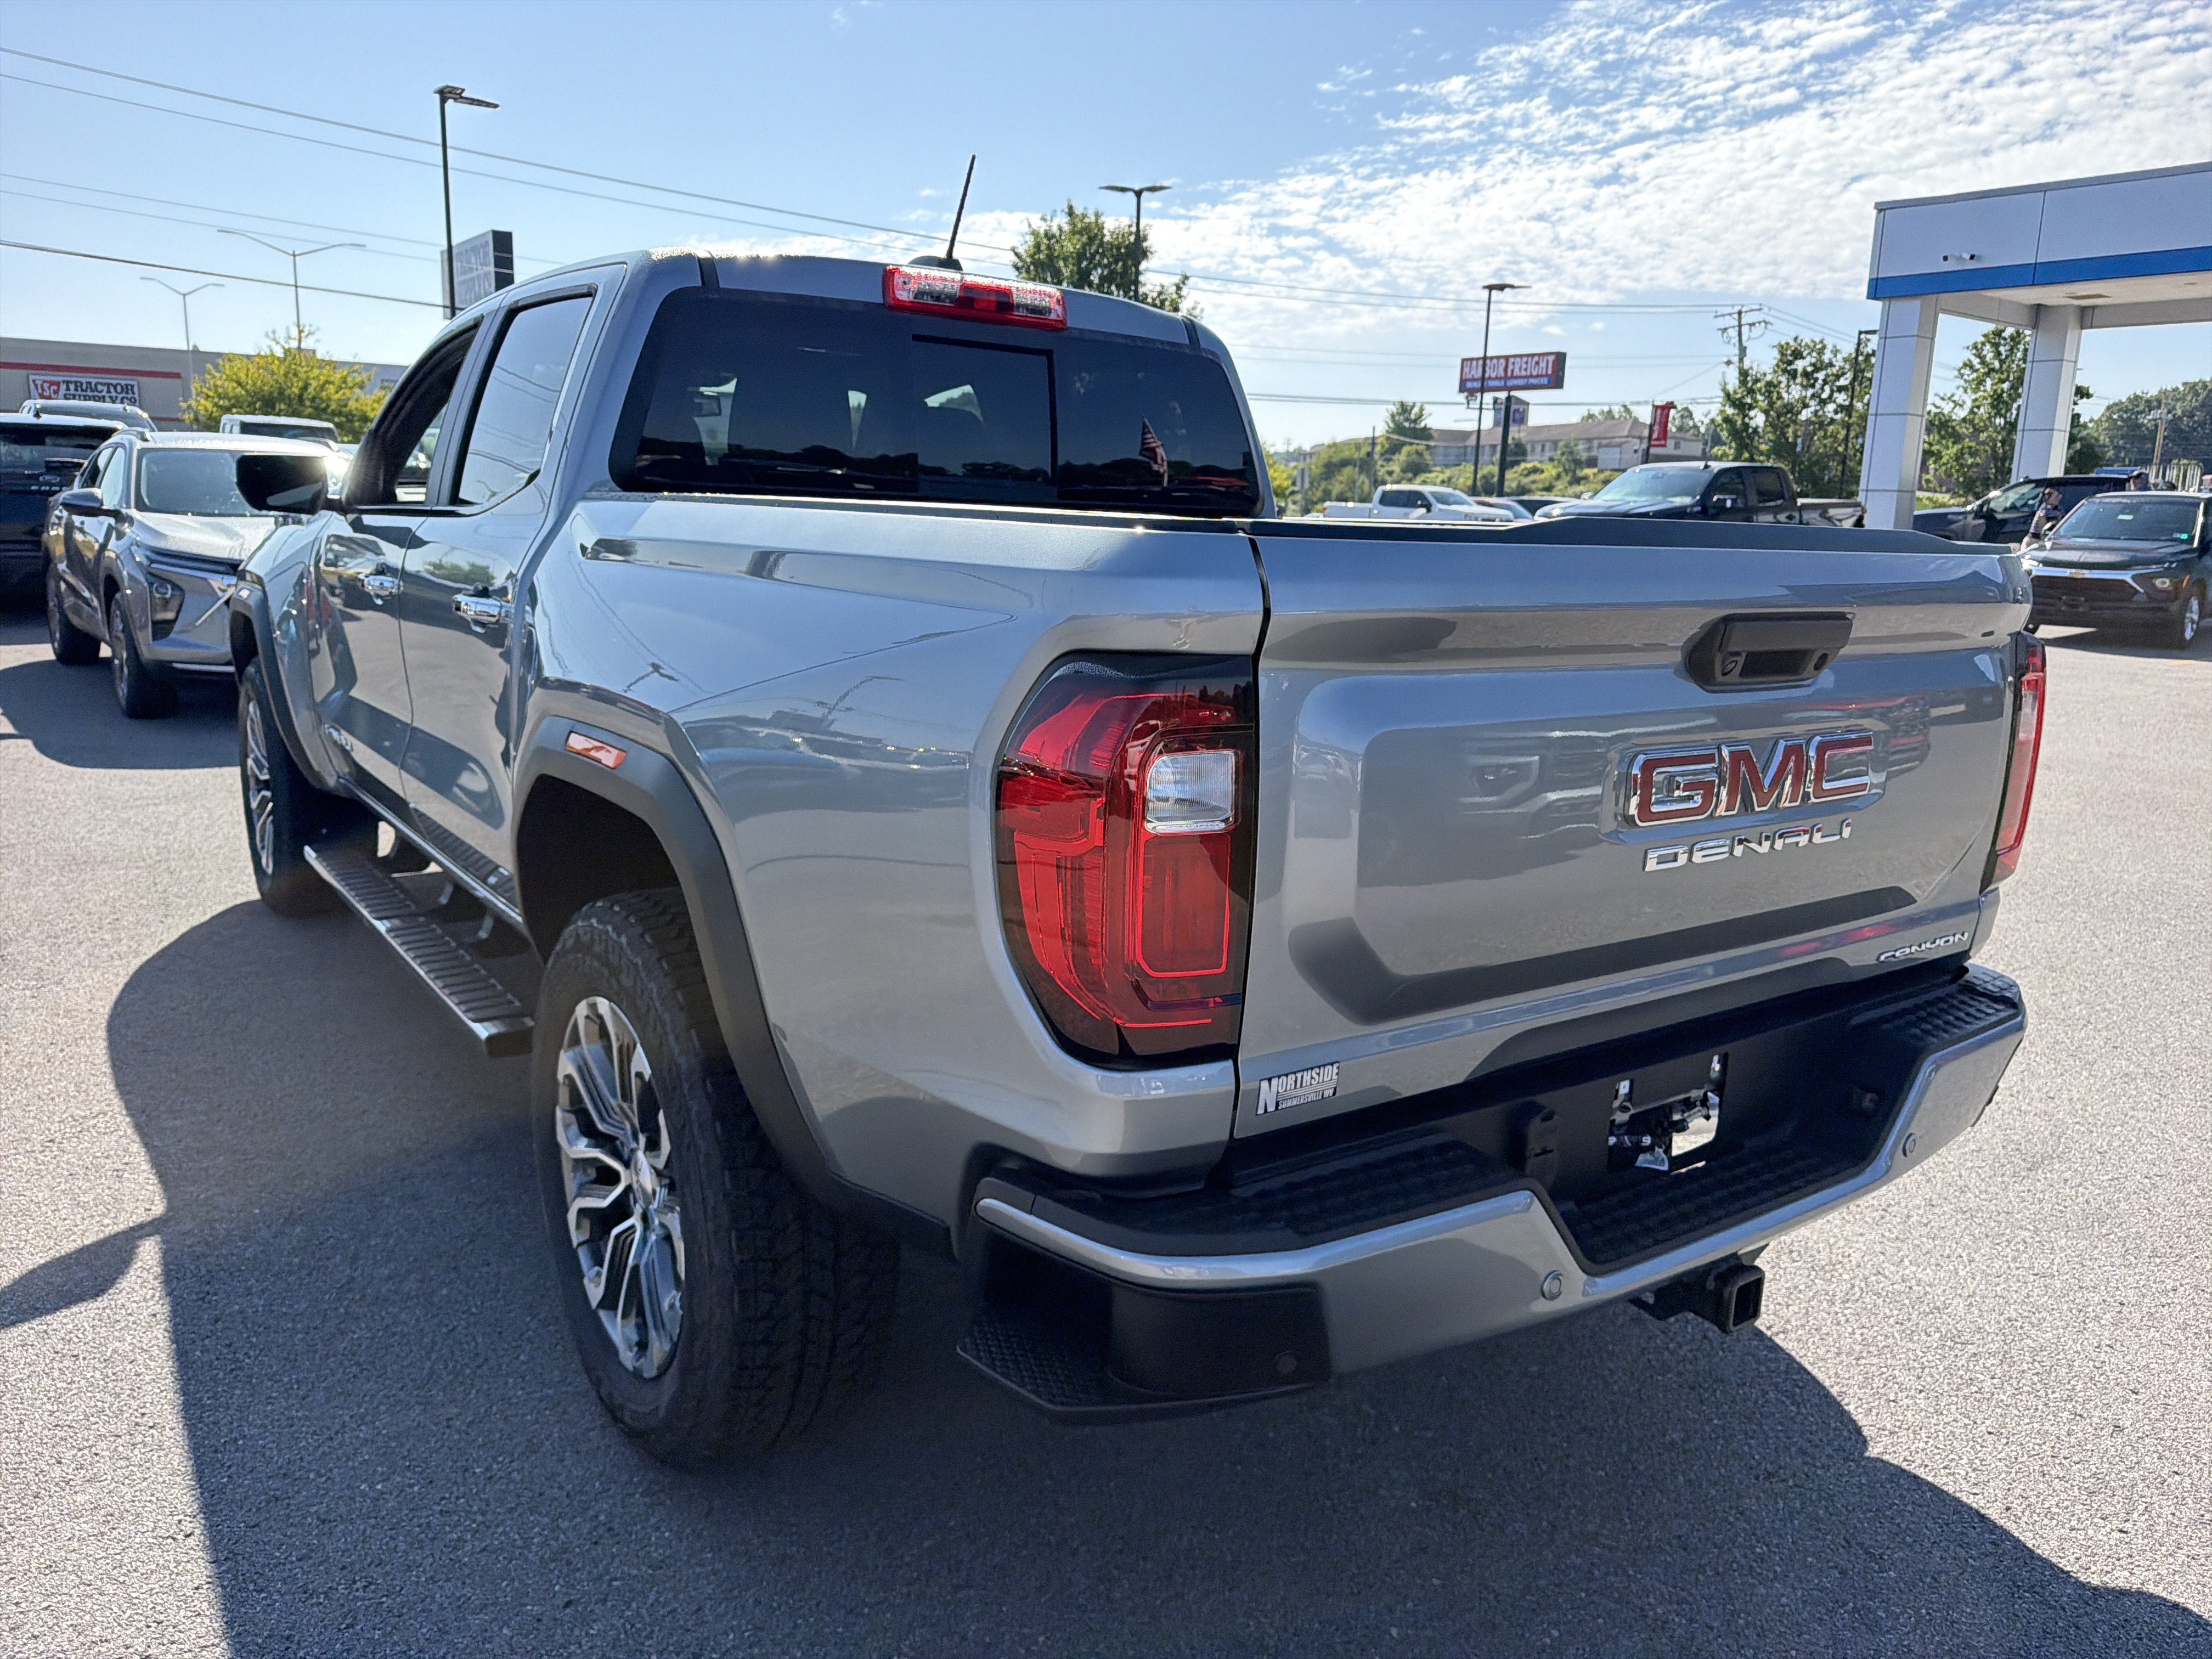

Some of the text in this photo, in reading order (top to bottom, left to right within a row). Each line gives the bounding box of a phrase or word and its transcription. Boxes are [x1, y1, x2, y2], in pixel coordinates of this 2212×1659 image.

[1508, 354, 1556, 377] FREIGHT
[33, 380, 136, 399] TSC TRACTOR
[1629, 731, 1874, 827] GMC
[1644, 819, 1852, 872] DENALI
[1878, 932, 1969, 962] CANYON
[1256, 1063, 1339, 1115] NORTHSIDE
[1278, 1087, 1335, 1110] SUMMERSVILLE WV
